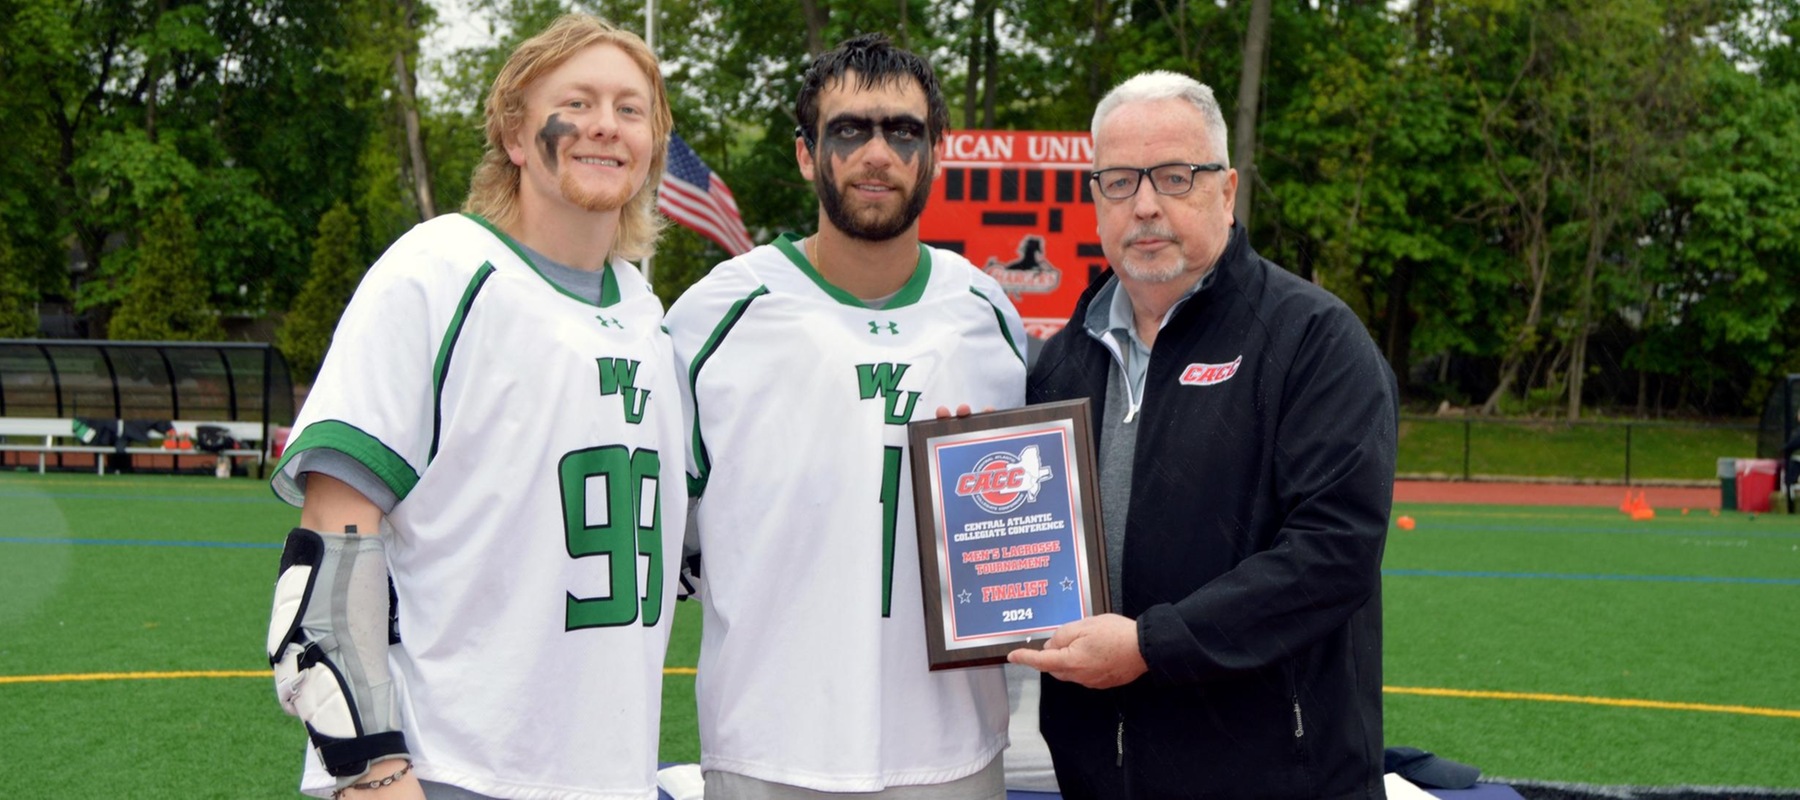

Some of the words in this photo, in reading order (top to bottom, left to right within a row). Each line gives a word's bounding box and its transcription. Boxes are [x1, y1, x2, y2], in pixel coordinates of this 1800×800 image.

[595, 357, 651, 424] WU
[855, 362, 922, 425] WU
[956, 466, 1025, 495] CACC
[879, 445, 903, 618] 1
[954, 528, 1007, 542] COLLEGIATE
[1008, 520, 1065, 535] CONFERENCE
[964, 519, 1005, 532] CENTRAL
[1007, 513, 1053, 527] ATLANTIC
[558, 444, 663, 632] 99
[962, 547, 1000, 563] MEN'S
[1001, 540, 1061, 558] LACROSSE
[975, 555, 1051, 575] TOURNAMENT
[981, 579, 1048, 603] FINALIST
[1002, 608, 1033, 622] 2024
